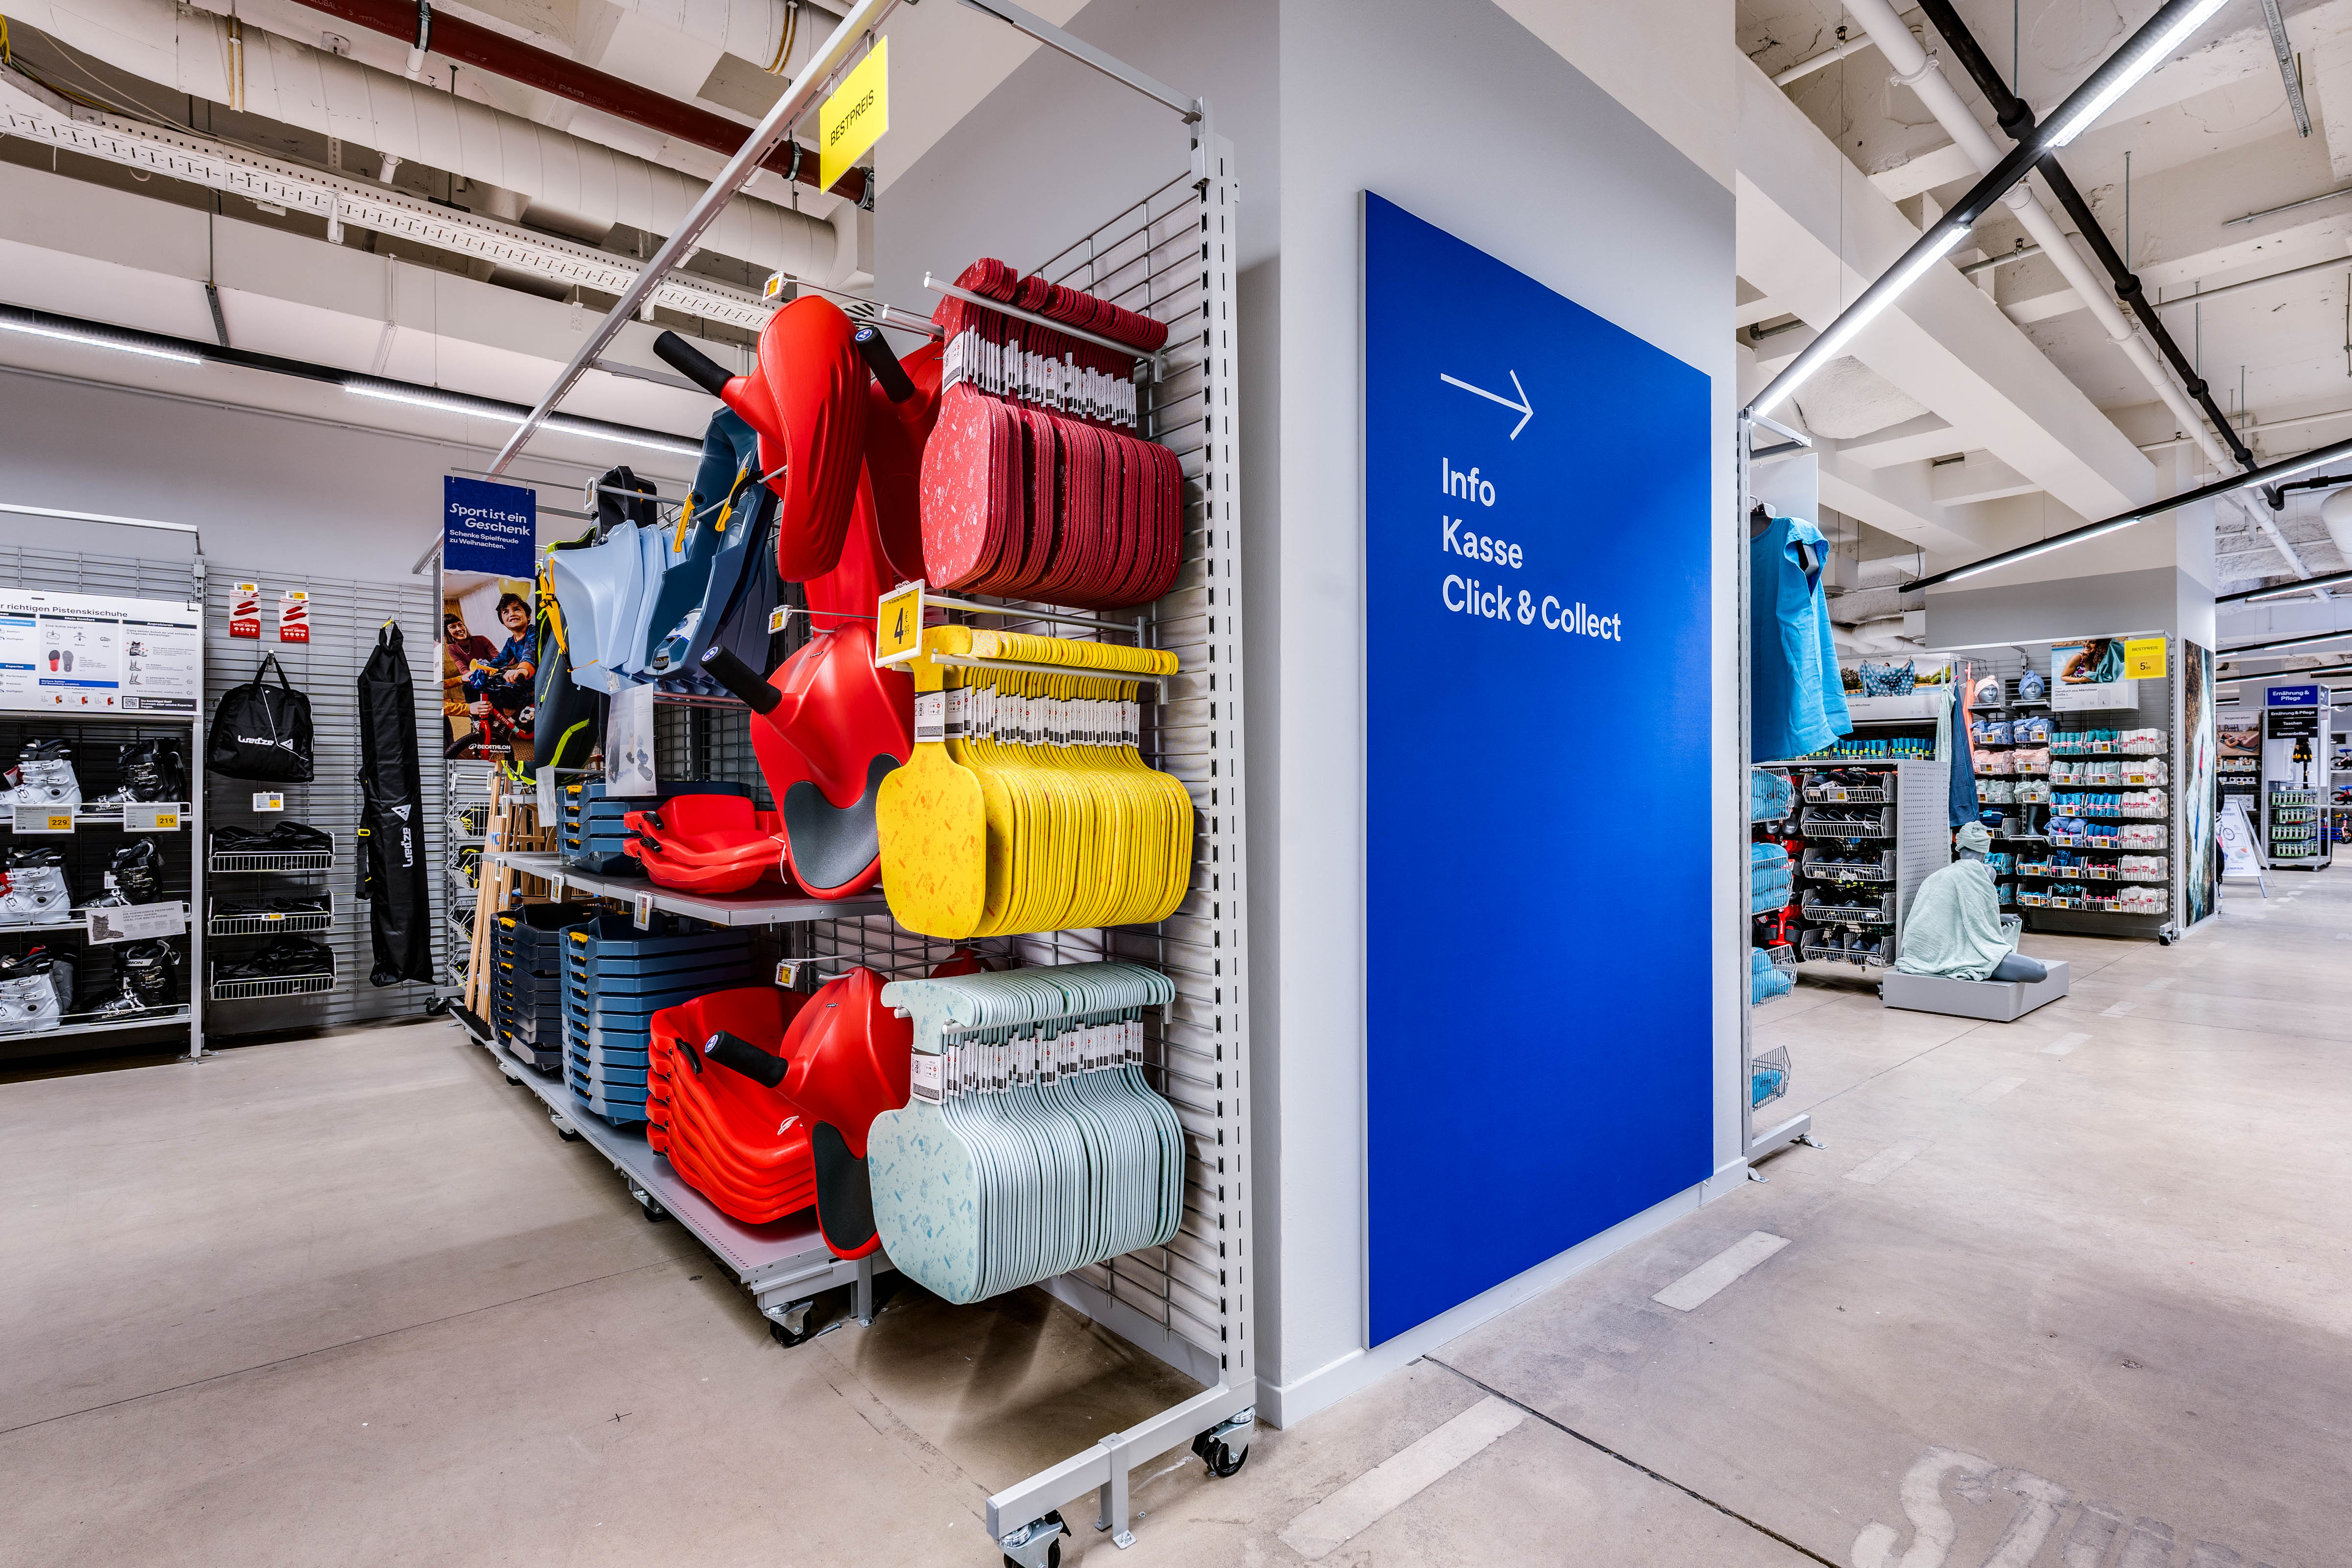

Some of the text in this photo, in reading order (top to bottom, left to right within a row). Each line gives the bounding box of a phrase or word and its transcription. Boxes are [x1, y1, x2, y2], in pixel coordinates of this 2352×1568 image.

[831, 89, 874, 147] BESTPREIS
[1442, 457, 1496, 507] Info
[449, 503, 527, 524] Sport ist ein
[449, 529, 519, 544] Schenke Spielfreude
[465, 517, 530, 536] Geschenk
[459, 538, 506, 549] Weihnachten.
[1443, 514, 1523, 569] Kasse
[7, 603, 50, 612] richtigen
[52, 606, 128, 617] Pistenskischuhe
[1442, 574, 1621, 642] Click & Collect
[894, 607, 904, 644] 4
[904, 624, 910, 635] 99
[2140, 662, 2146, 671] 5
